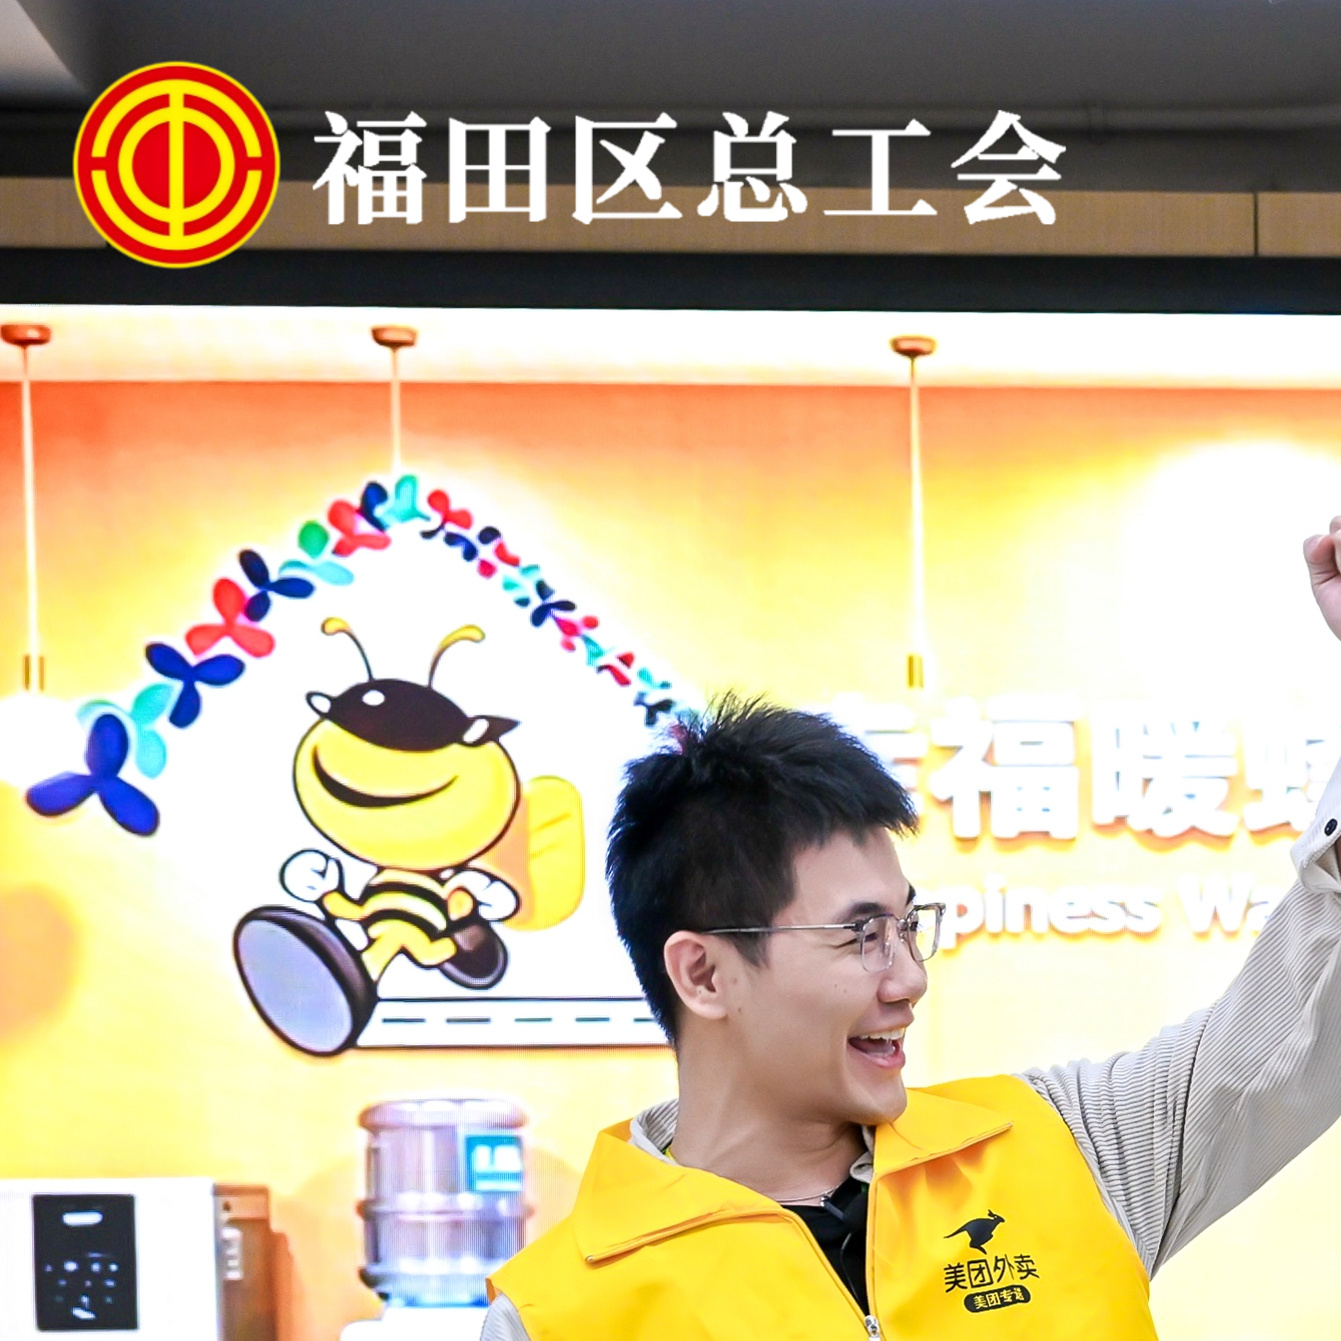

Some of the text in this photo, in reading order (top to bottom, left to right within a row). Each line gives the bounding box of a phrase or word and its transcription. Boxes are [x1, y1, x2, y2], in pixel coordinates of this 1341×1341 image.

[915, 874, 1161, 952] piness
[943, 1253, 1040, 1293] 美团外卖
